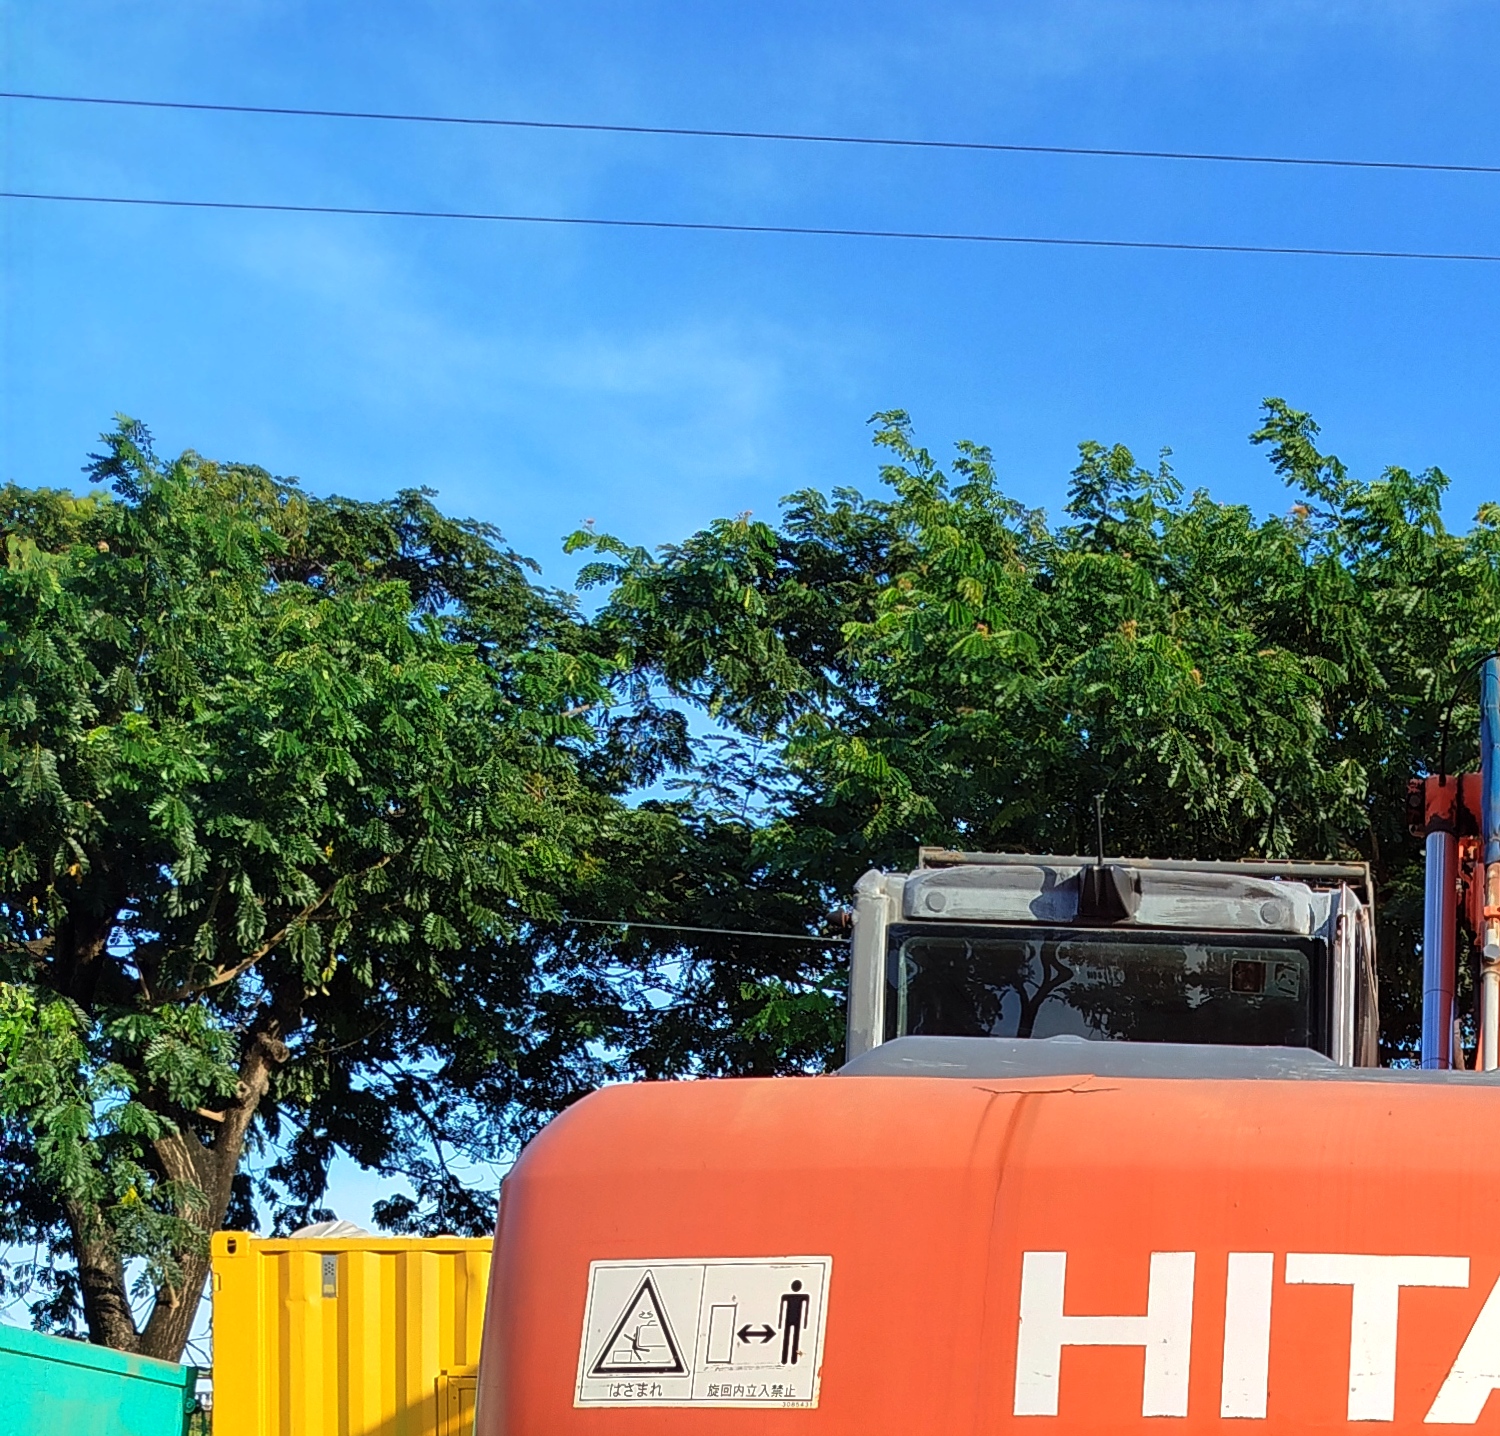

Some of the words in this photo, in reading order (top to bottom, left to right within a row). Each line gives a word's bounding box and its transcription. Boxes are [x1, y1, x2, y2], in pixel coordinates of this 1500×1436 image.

[707, 1383, 797, 1398] 旋回内立入禁止
